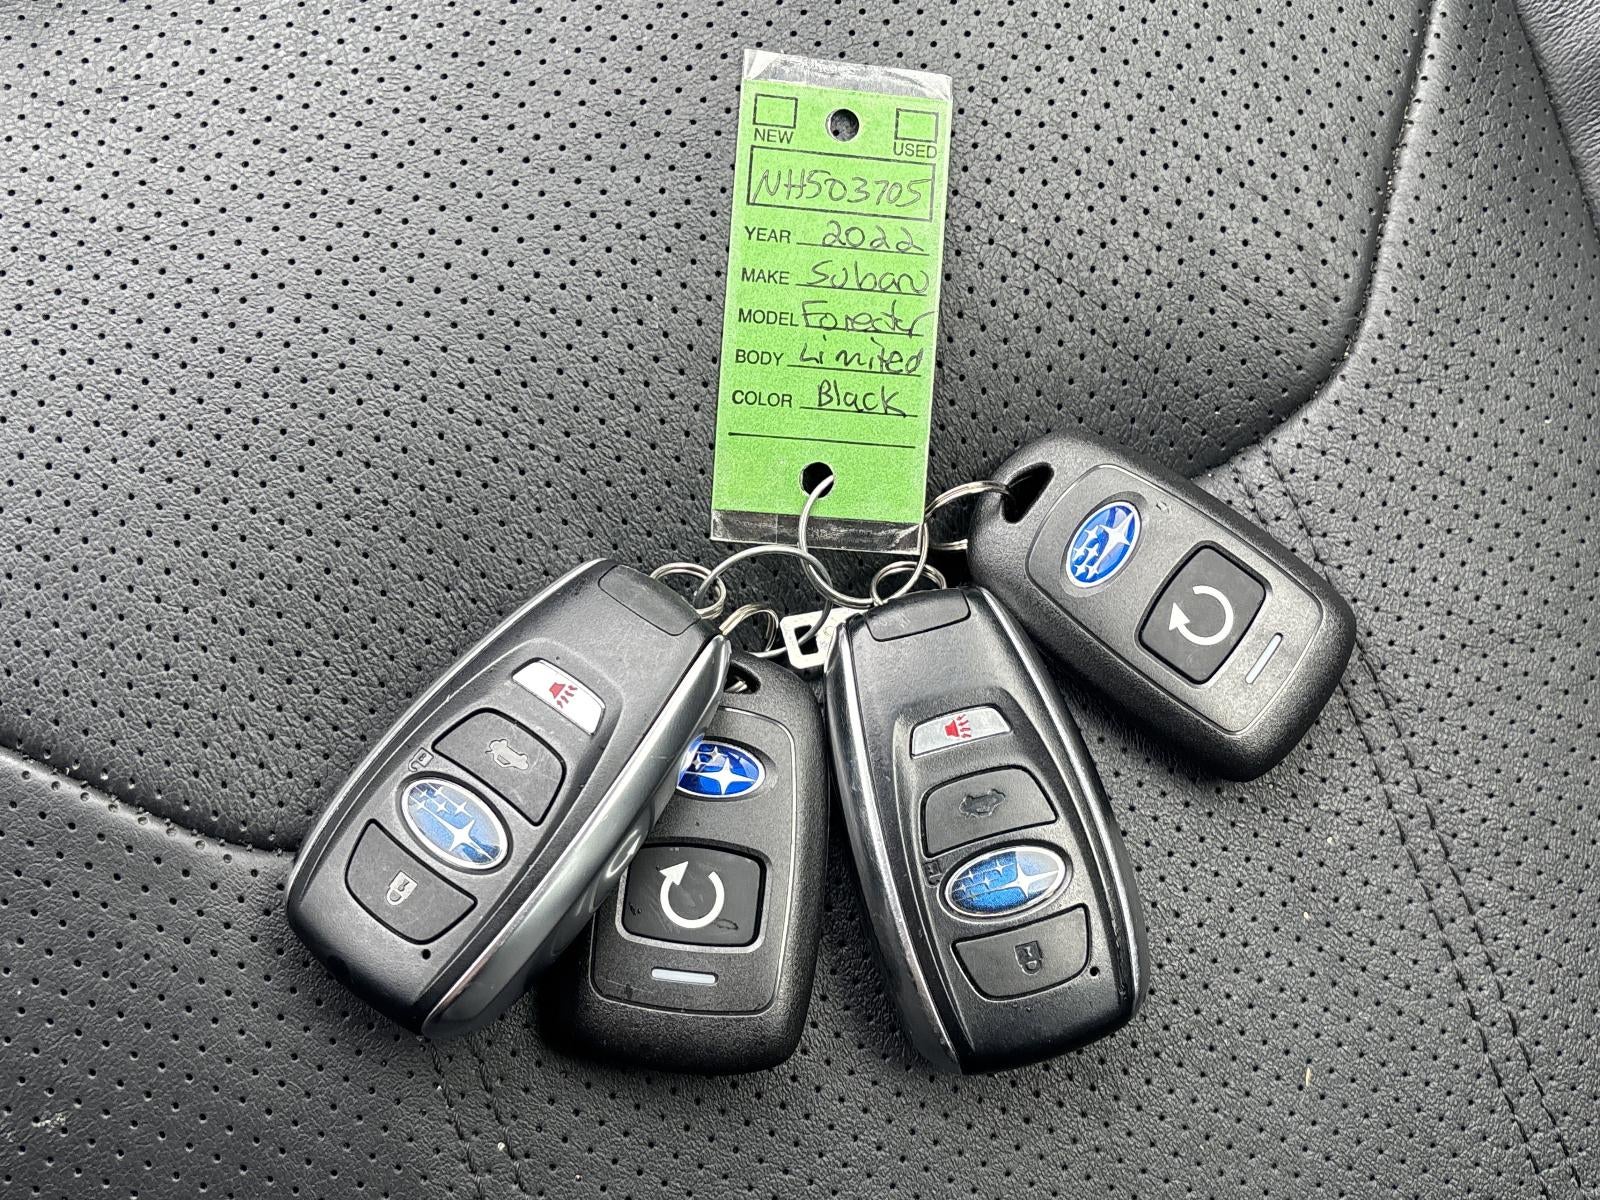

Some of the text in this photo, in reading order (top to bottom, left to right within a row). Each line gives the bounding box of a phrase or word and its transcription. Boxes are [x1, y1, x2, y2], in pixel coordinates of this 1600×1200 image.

[753, 128, 794, 145] NEW
[893, 142, 937, 159] USED
[751, 168, 932, 208] NH503705
[744, 219, 925, 254] YEAR 2022
[741, 267, 790, 285] MAKE
[738, 307, 799, 327] MODEL
[735, 334, 924, 374] BODY Limited
[731, 379, 907, 418] COLOR Black
